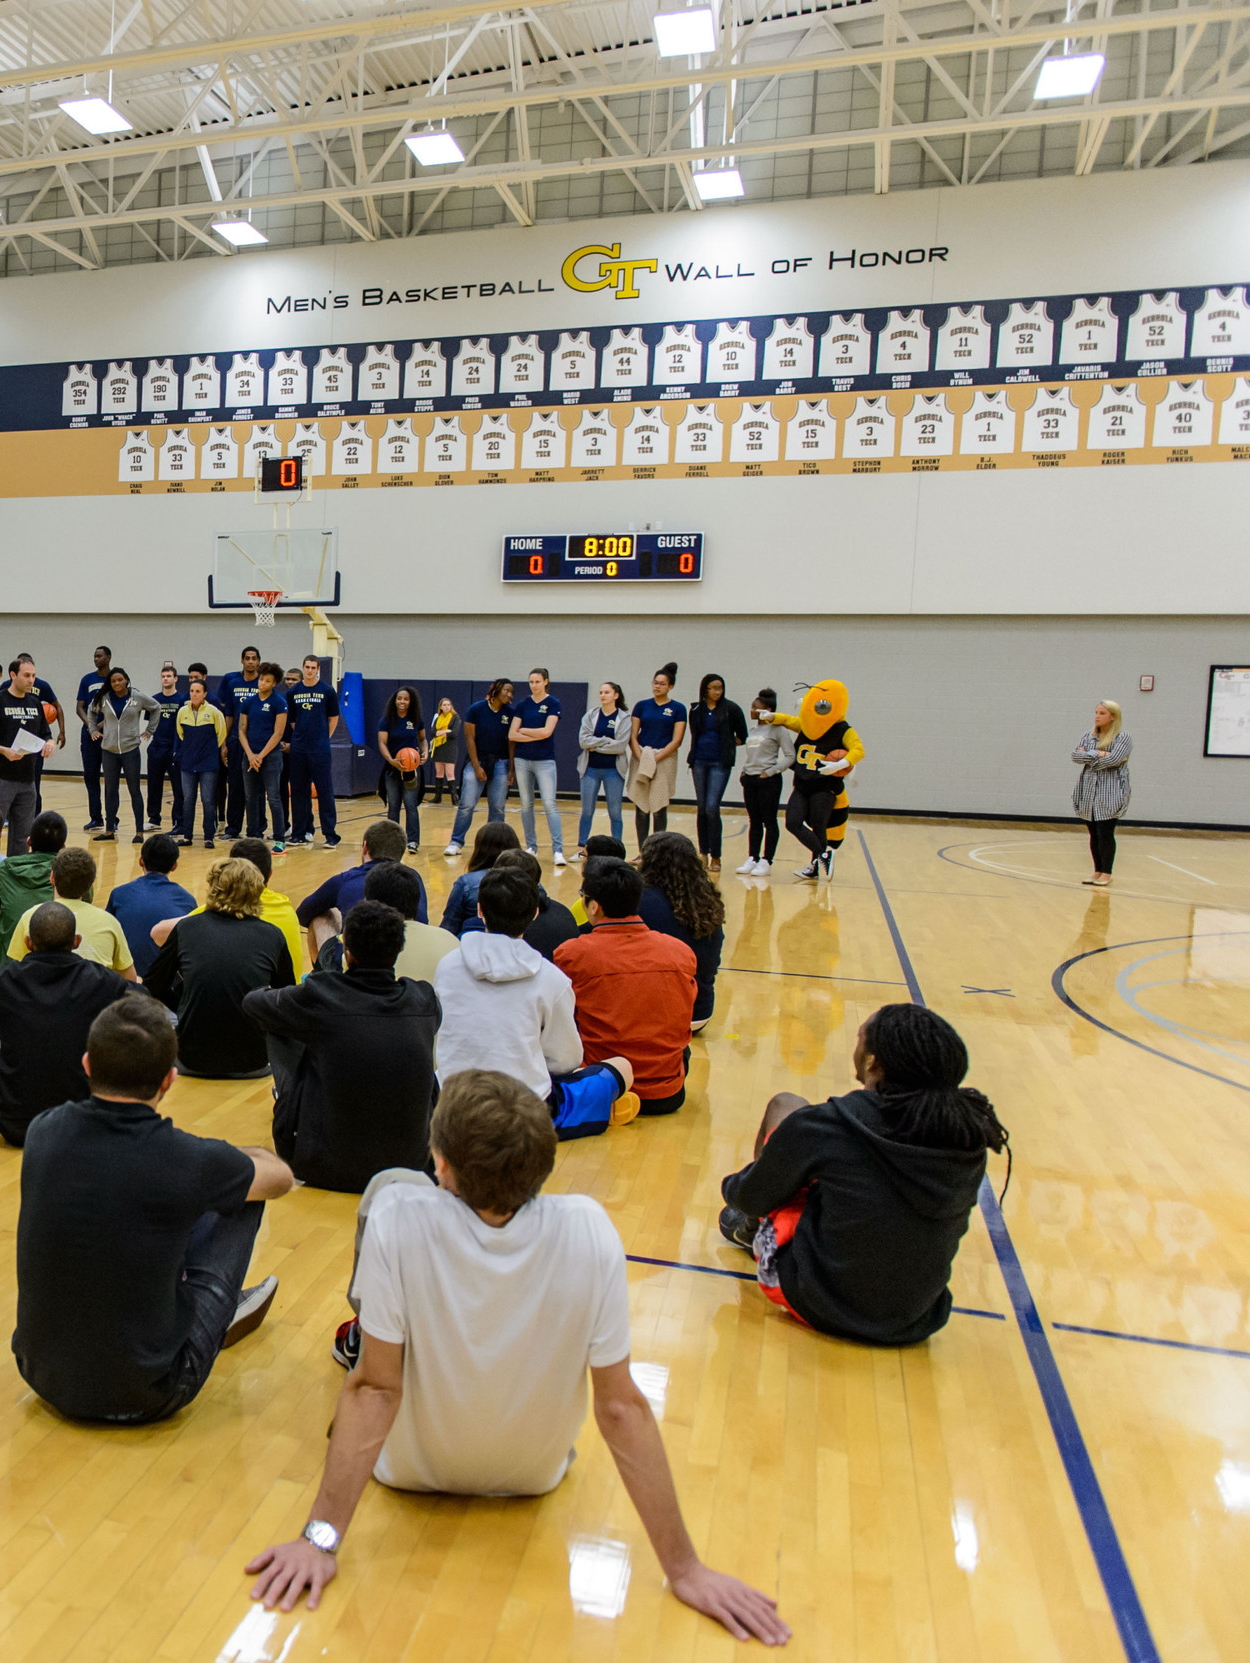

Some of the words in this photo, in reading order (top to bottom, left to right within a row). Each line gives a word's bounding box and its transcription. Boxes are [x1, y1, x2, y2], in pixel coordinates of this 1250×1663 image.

[561, 242, 658, 300] GT
[1148, 326, 1163, 336] 52
[1219, 322, 1226, 332] 4
[959, 338, 968, 347] 11
[1018, 334, 1033, 343] 52
[842, 345, 848, 354] 3
[900, 341, 906, 350] 4
[726, 352, 736, 360] 10
[784, 348, 793, 357] 14
[618, 357, 630, 366] 44
[673, 354, 682, 363] 12
[517, 363, 528, 372] 24
[570, 361, 576, 369] 5
[421, 370, 429, 378] 14
[468, 367, 479, 375] 24
[327, 375, 338, 383] 45
[377, 372, 382, 380] 3
[240, 380, 249, 388] 34
[282, 378, 293, 386] 33
[73, 389, 87, 397] 354
[112, 387, 126, 395] 292
[153, 385, 166, 393] 190
[1111, 416, 1123, 425] 21
[1176, 413, 1192, 422] 40
[1043, 419, 1058, 428] 33
[805, 430, 817, 438] 15
[867, 427, 873, 436] 3
[921, 425, 935, 434] 23
[641, 435, 650, 444] 14
[693, 433, 706, 442] 33
[749, 432, 761, 440] 52
[488, 442, 499, 450] 20
[538, 440, 549, 448] 15
[592, 438, 597, 446] 3
[443, 444, 448, 452] 5
[172, 454, 182, 462] 33
[218, 452, 222, 460] 5
[281, 460, 296, 487] 0
[510, 538, 543, 550] HOME
[584, 537, 632, 557] 8:00
[657, 536, 697, 547] GUEST
[529, 555, 543, 574] 0
[680, 553, 693, 573] 0
[575, 566, 602, 575] PERIOD
[606, 561, 617, 576] 0
[797, 744, 826, 770] GT
